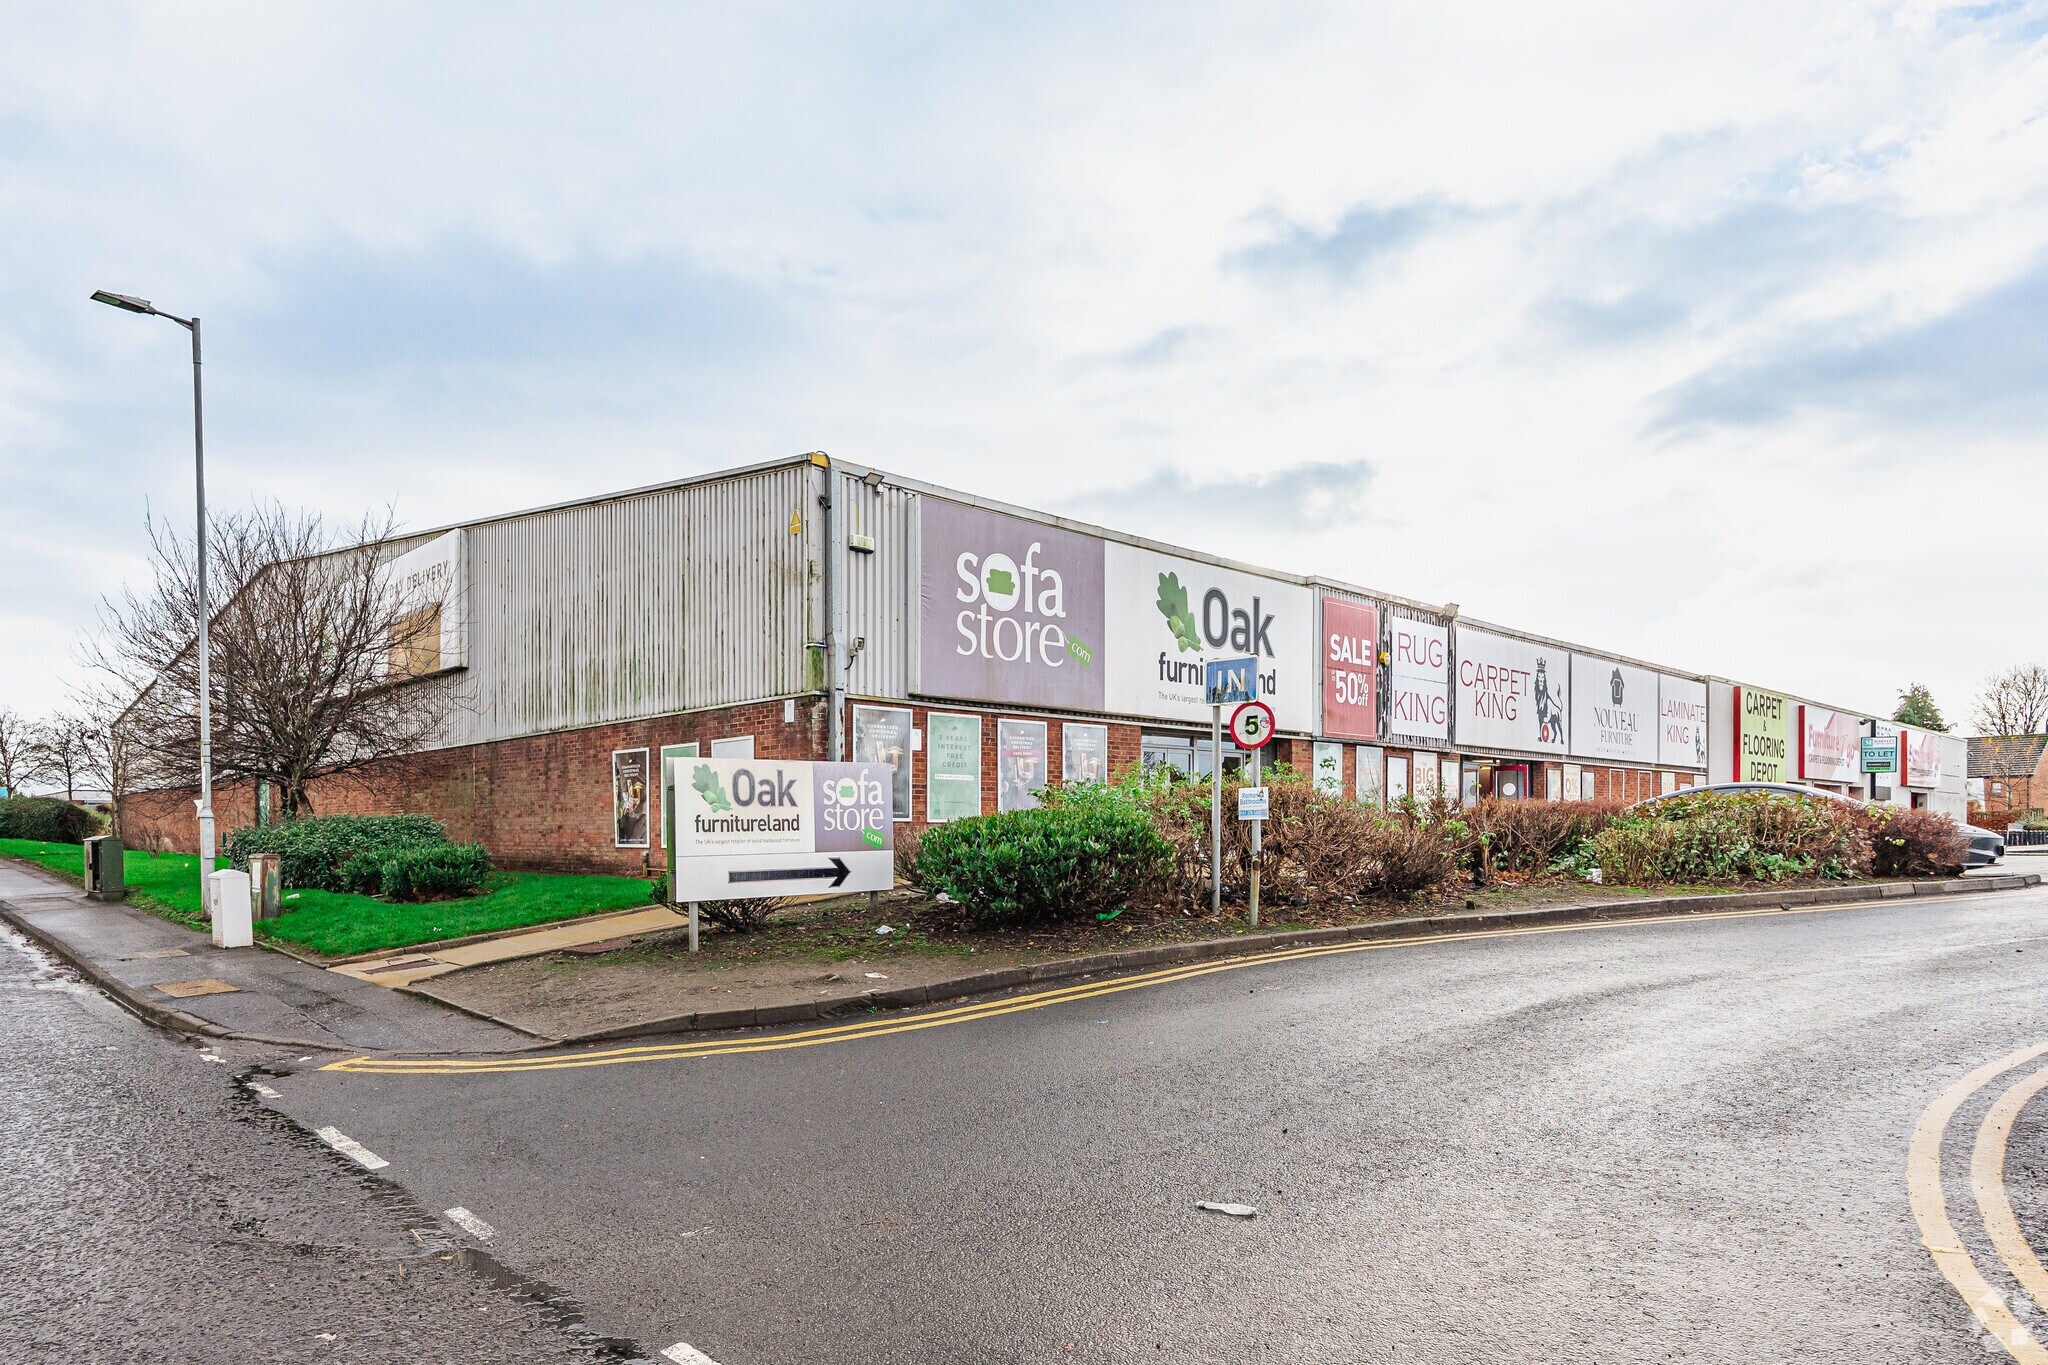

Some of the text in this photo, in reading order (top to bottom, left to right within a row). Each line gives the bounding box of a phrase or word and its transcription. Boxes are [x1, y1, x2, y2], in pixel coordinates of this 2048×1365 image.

[956, 542, 1066, 618] sofa
[956, 603, 1066, 667] store
[1203, 587, 1276, 658] Oak
[1330, 634, 1371, 667] SALE
[1397, 632, 1443, 668] RUG
[1158, 652, 1276, 695] furnind
[1217, 668, 1245, 693] IN
[1460, 660, 1531, 697] CARPET
[1158, 691, 1168, 700] The
[1181, 695, 1199, 705] largest
[1335, 670, 1369, 705] 50%
[1357, 693, 1369, 707] off
[1394, 690, 1446, 725] KING
[1475, 690, 1517, 721] KING
[1661, 698, 1706, 723] LAMINATE
[1746, 691, 1782, 720] CARPET
[1244, 715, 1259, 735] 5
[1593, 706, 1640, 732] NOUVEAU
[937, 743, 971, 751] INTEREST
[1600, 730, 1633, 746] FURNITURE
[1666, 723, 1690, 745] KING
[1743, 733, 1785, 759] FLOORING
[942, 761, 968, 769] CREDIT
[1863, 750, 1895, 758] TO LET
[1415, 767, 1434, 784] BIG
[1750, 761, 1778, 783] DEPOT
[732, 768, 799, 808] Oak
[823, 768, 884, 806] sofa
[695, 814, 800, 833] furnitureland
[823, 803, 884, 831] store
[715, 838, 730, 846] largest
[730, 837, 746, 845] retailer
[866, 830, 883, 846] com
